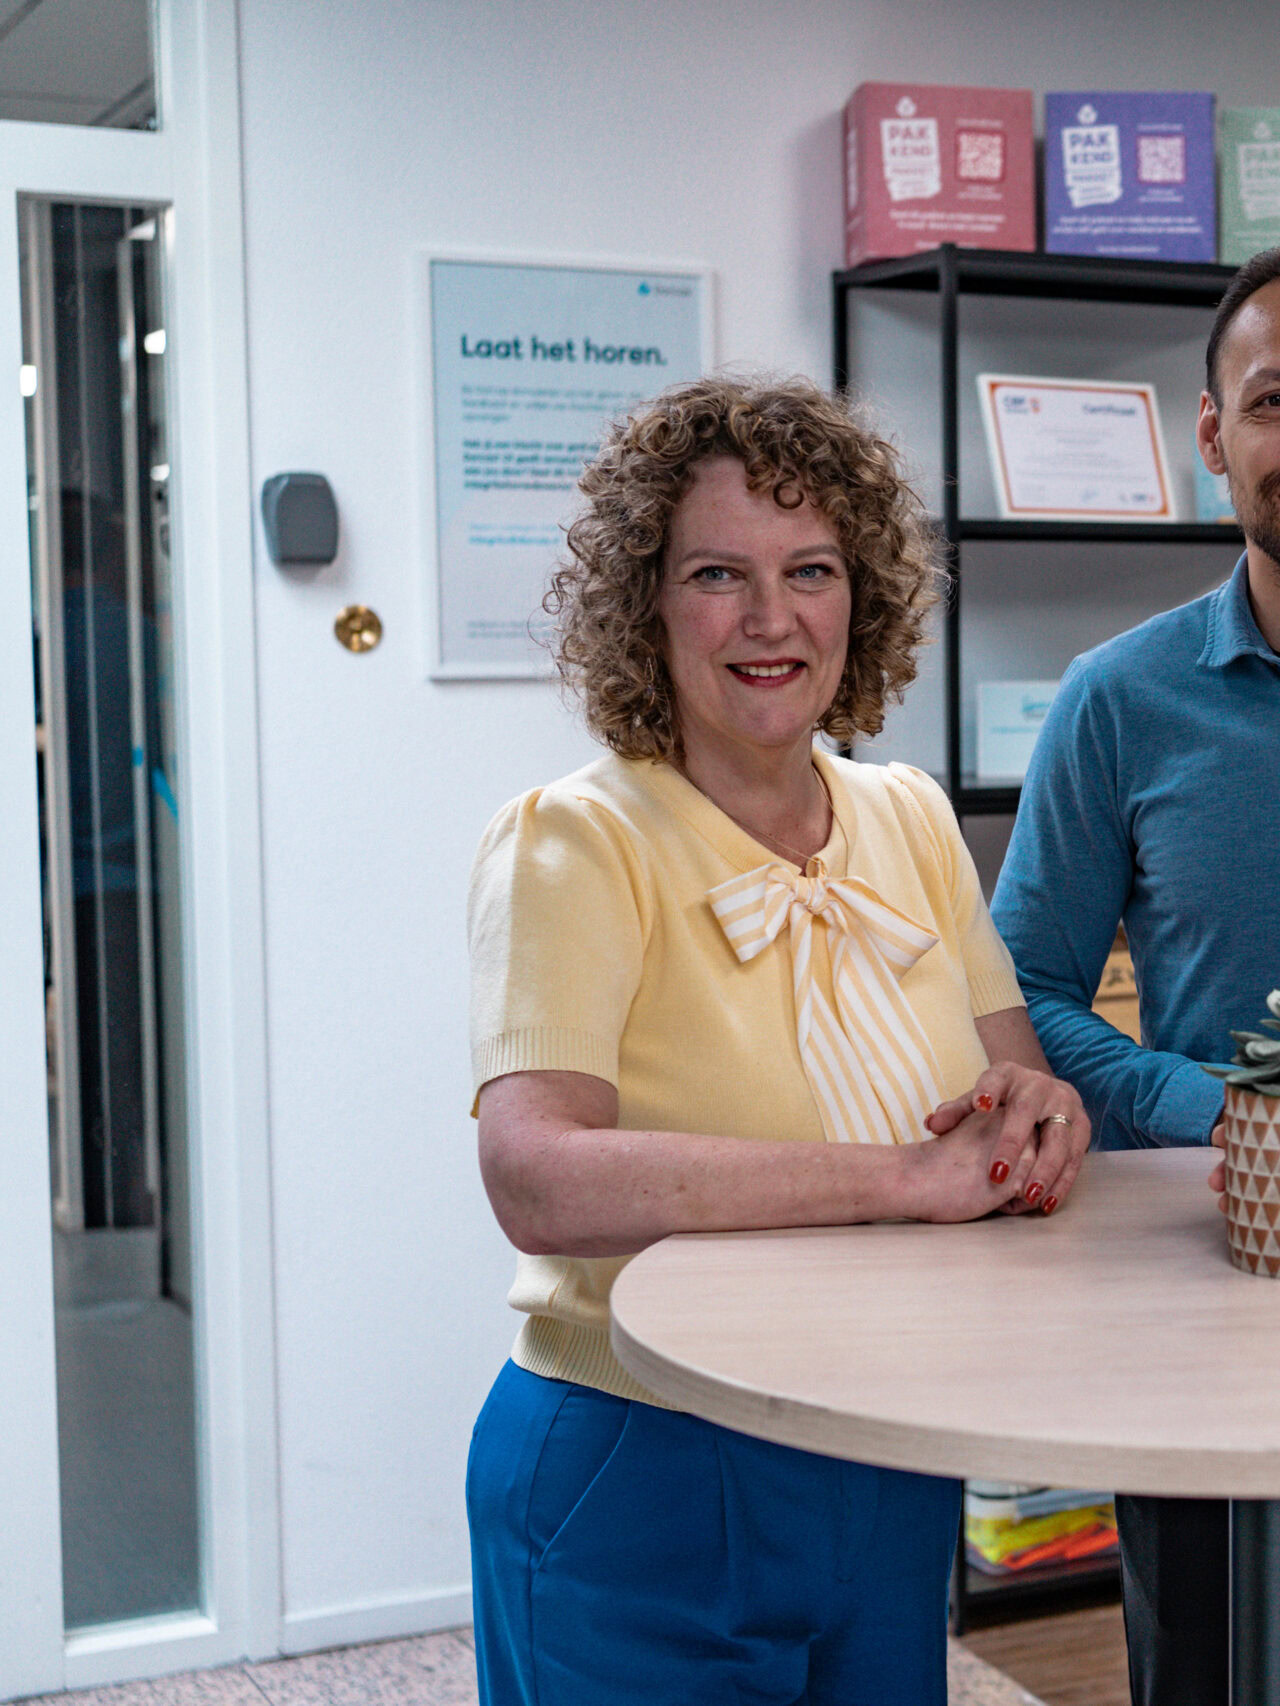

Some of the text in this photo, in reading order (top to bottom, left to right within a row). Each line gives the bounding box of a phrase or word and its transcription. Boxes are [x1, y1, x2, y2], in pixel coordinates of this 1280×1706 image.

[889, 125, 929, 139] PAK
[1069, 132, 1110, 148] PAK
[461, 333, 668, 366] Laat het horen.
